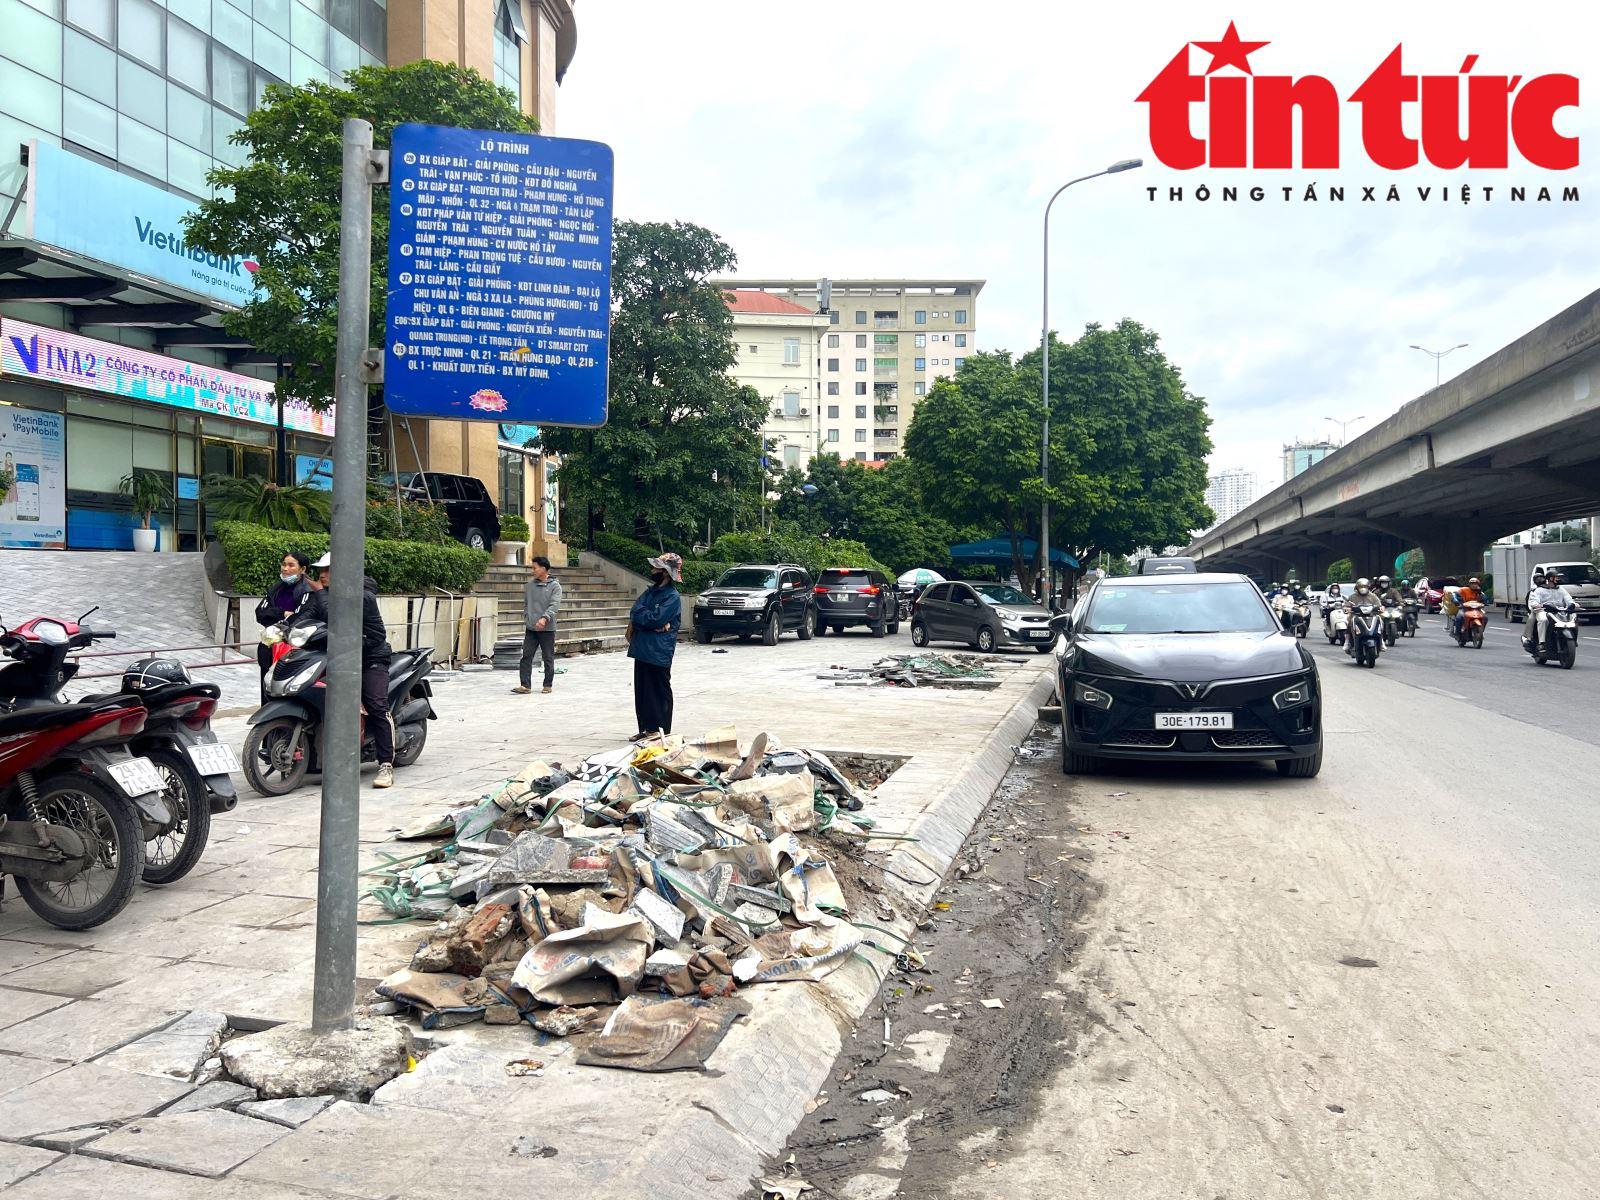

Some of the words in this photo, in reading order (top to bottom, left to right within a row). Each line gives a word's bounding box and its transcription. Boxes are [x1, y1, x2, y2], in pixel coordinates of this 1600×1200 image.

[480, 137, 495, 154] LỘ
[496, 139, 530, 155] TRÌNH
[419, 154, 431, 165] BX
[432, 153, 451, 167] GIÁP
[452, 155, 468, 168] BÁT
[444, 170, 461, 183] VẠN
[462, 169, 483, 182] PHÚC
[418, 180, 429, 191] BX
[430, 179, 448, 192] GIÁP
[523, 189, 546, 203] PHẠM
[585, 194, 605, 207] TÙNG
[469, 198, 479, 209] QL
[479, 199, 490, 209] 32
[519, 202, 541, 215] TRẠM
[564, 204, 579, 217] TÂN
[580, 206, 594, 221] LẬP
[433, 206, 455, 219] PHÁP
[456, 208, 472, 221] VÂN
[484, 210, 503, 225] HIỆP
[559, 219, 580, 233] NGỌC
[415, 231, 436, 244] GIÁM
[442, 235, 466, 248] PHẠM
[467, 235, 489, 248] HÙNG
[495, 239, 506, 249] CV
[541, 241, 556, 253] TÂY
[548, 228, 575, 242] HOÀNG
[578, 234, 599, 245] MINH
[415, 246, 432, 256] TAM
[433, 245, 452, 260] HIỆP
[458, 249, 480, 260] PHAN
[481, 251, 506, 264] TRỌNG
[507, 250, 522, 265] TUỆ
[414, 274, 425, 284] BX
[427, 272, 445, 285] GIÁP
[446, 274, 461, 286] BÁT
[534, 283, 552, 293] LINH
[576, 286, 590, 299] ĐẠI
[591, 286, 601, 300] LỘ
[414, 288, 429, 298] CHU
[431, 287, 447, 299] VĂN
[448, 290, 459, 300] AN
[484, 293, 489, 302] 3
[502, 294, 512, 304] LA
[519, 293, 545, 307] PHÙNG
[413, 300, 432, 315] HIỆU
[437, 304, 448, 315] QL
[449, 305, 455, 314] 6
[480, 307, 505, 318] GIANG
[410, 316, 422, 326] BX
[422, 315, 440, 327] GIÁP
[441, 316, 455, 328] BÁT
[408, 331, 434, 342] QUANG
[488, 336, 513, 348] TRỌNG
[547, 341, 573, 351] SMART
[573, 343, 589, 352] CITY
[408, 345, 420, 355] BX
[443, 348, 464, 358] NINH
[470, 349, 481, 360] QL
[482, 350, 492, 360] 21
[544, 354, 562, 367] ĐẠO
[567, 356, 578, 367] QL
[578, 357, 595, 367] 21B
[142, 365, 158, 378] TY
[408, 360, 419, 371] QL
[420, 361, 424, 370] 1
[432, 358, 459, 372] KHUẤT
[502, 366, 513, 376] BX
[233, 404, 249, 416] VC2
[13, 413, 59, 428] VietinBank
[1161, 716, 1226, 727] 30E-179.81
